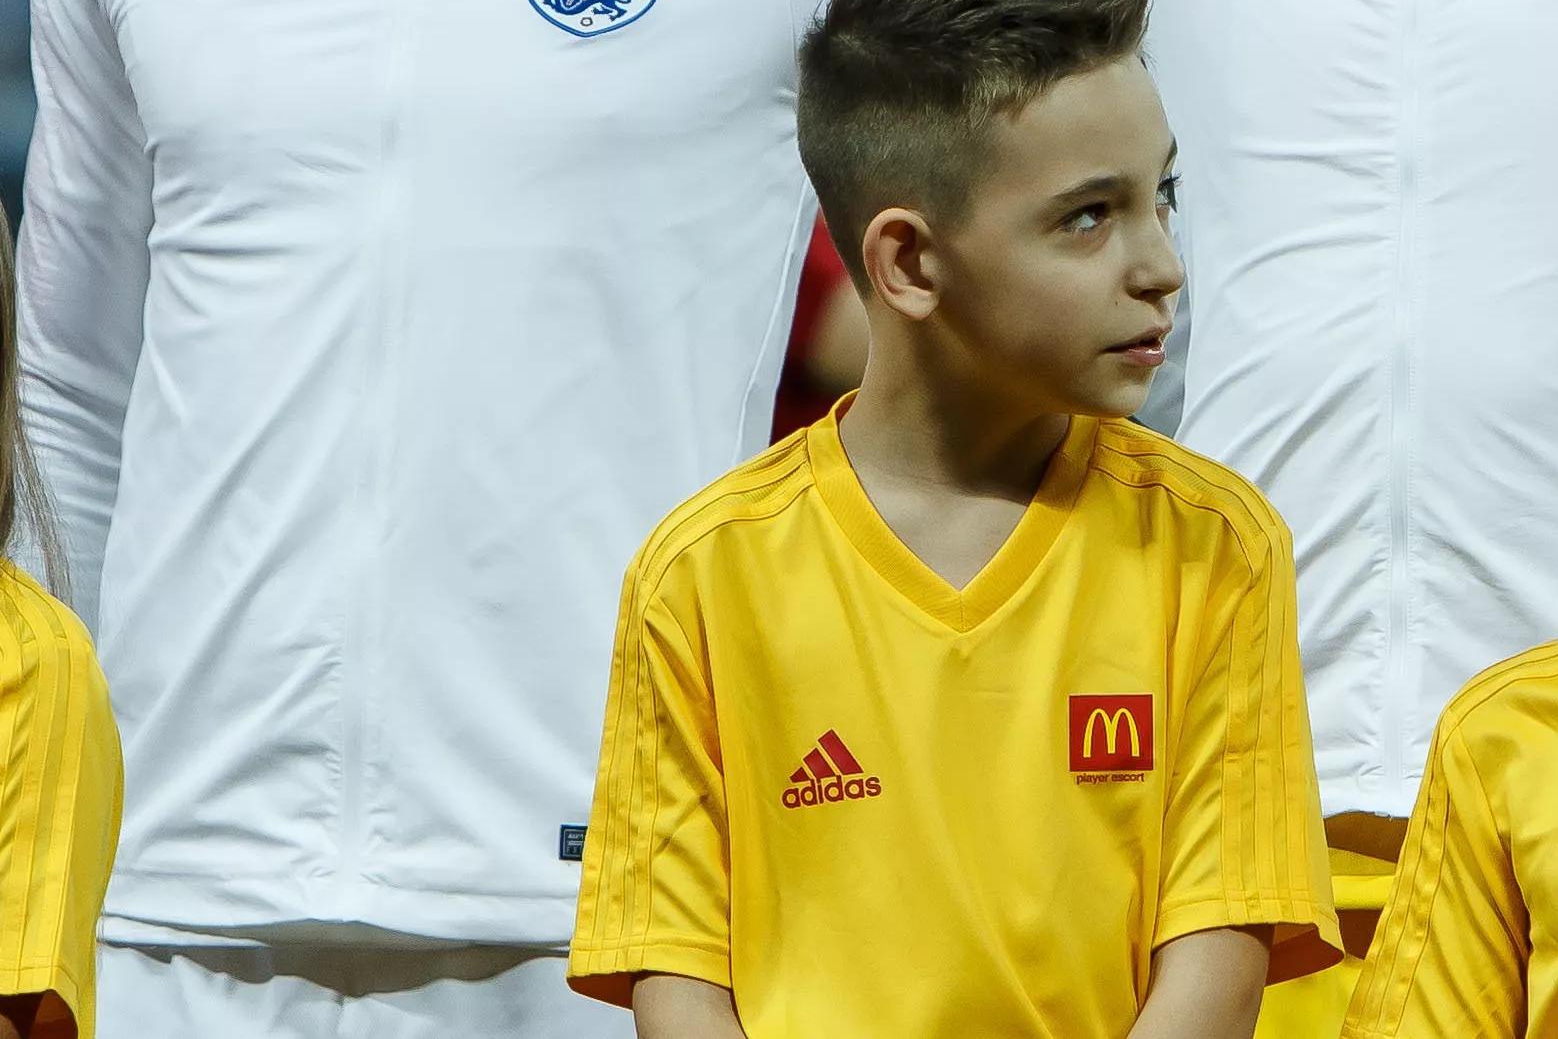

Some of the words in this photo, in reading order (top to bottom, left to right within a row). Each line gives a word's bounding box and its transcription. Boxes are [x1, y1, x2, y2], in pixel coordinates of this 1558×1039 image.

[1076, 773, 1109, 785] player
[1112, 772, 1145, 782] escort
[781, 774, 882, 809] adidas
